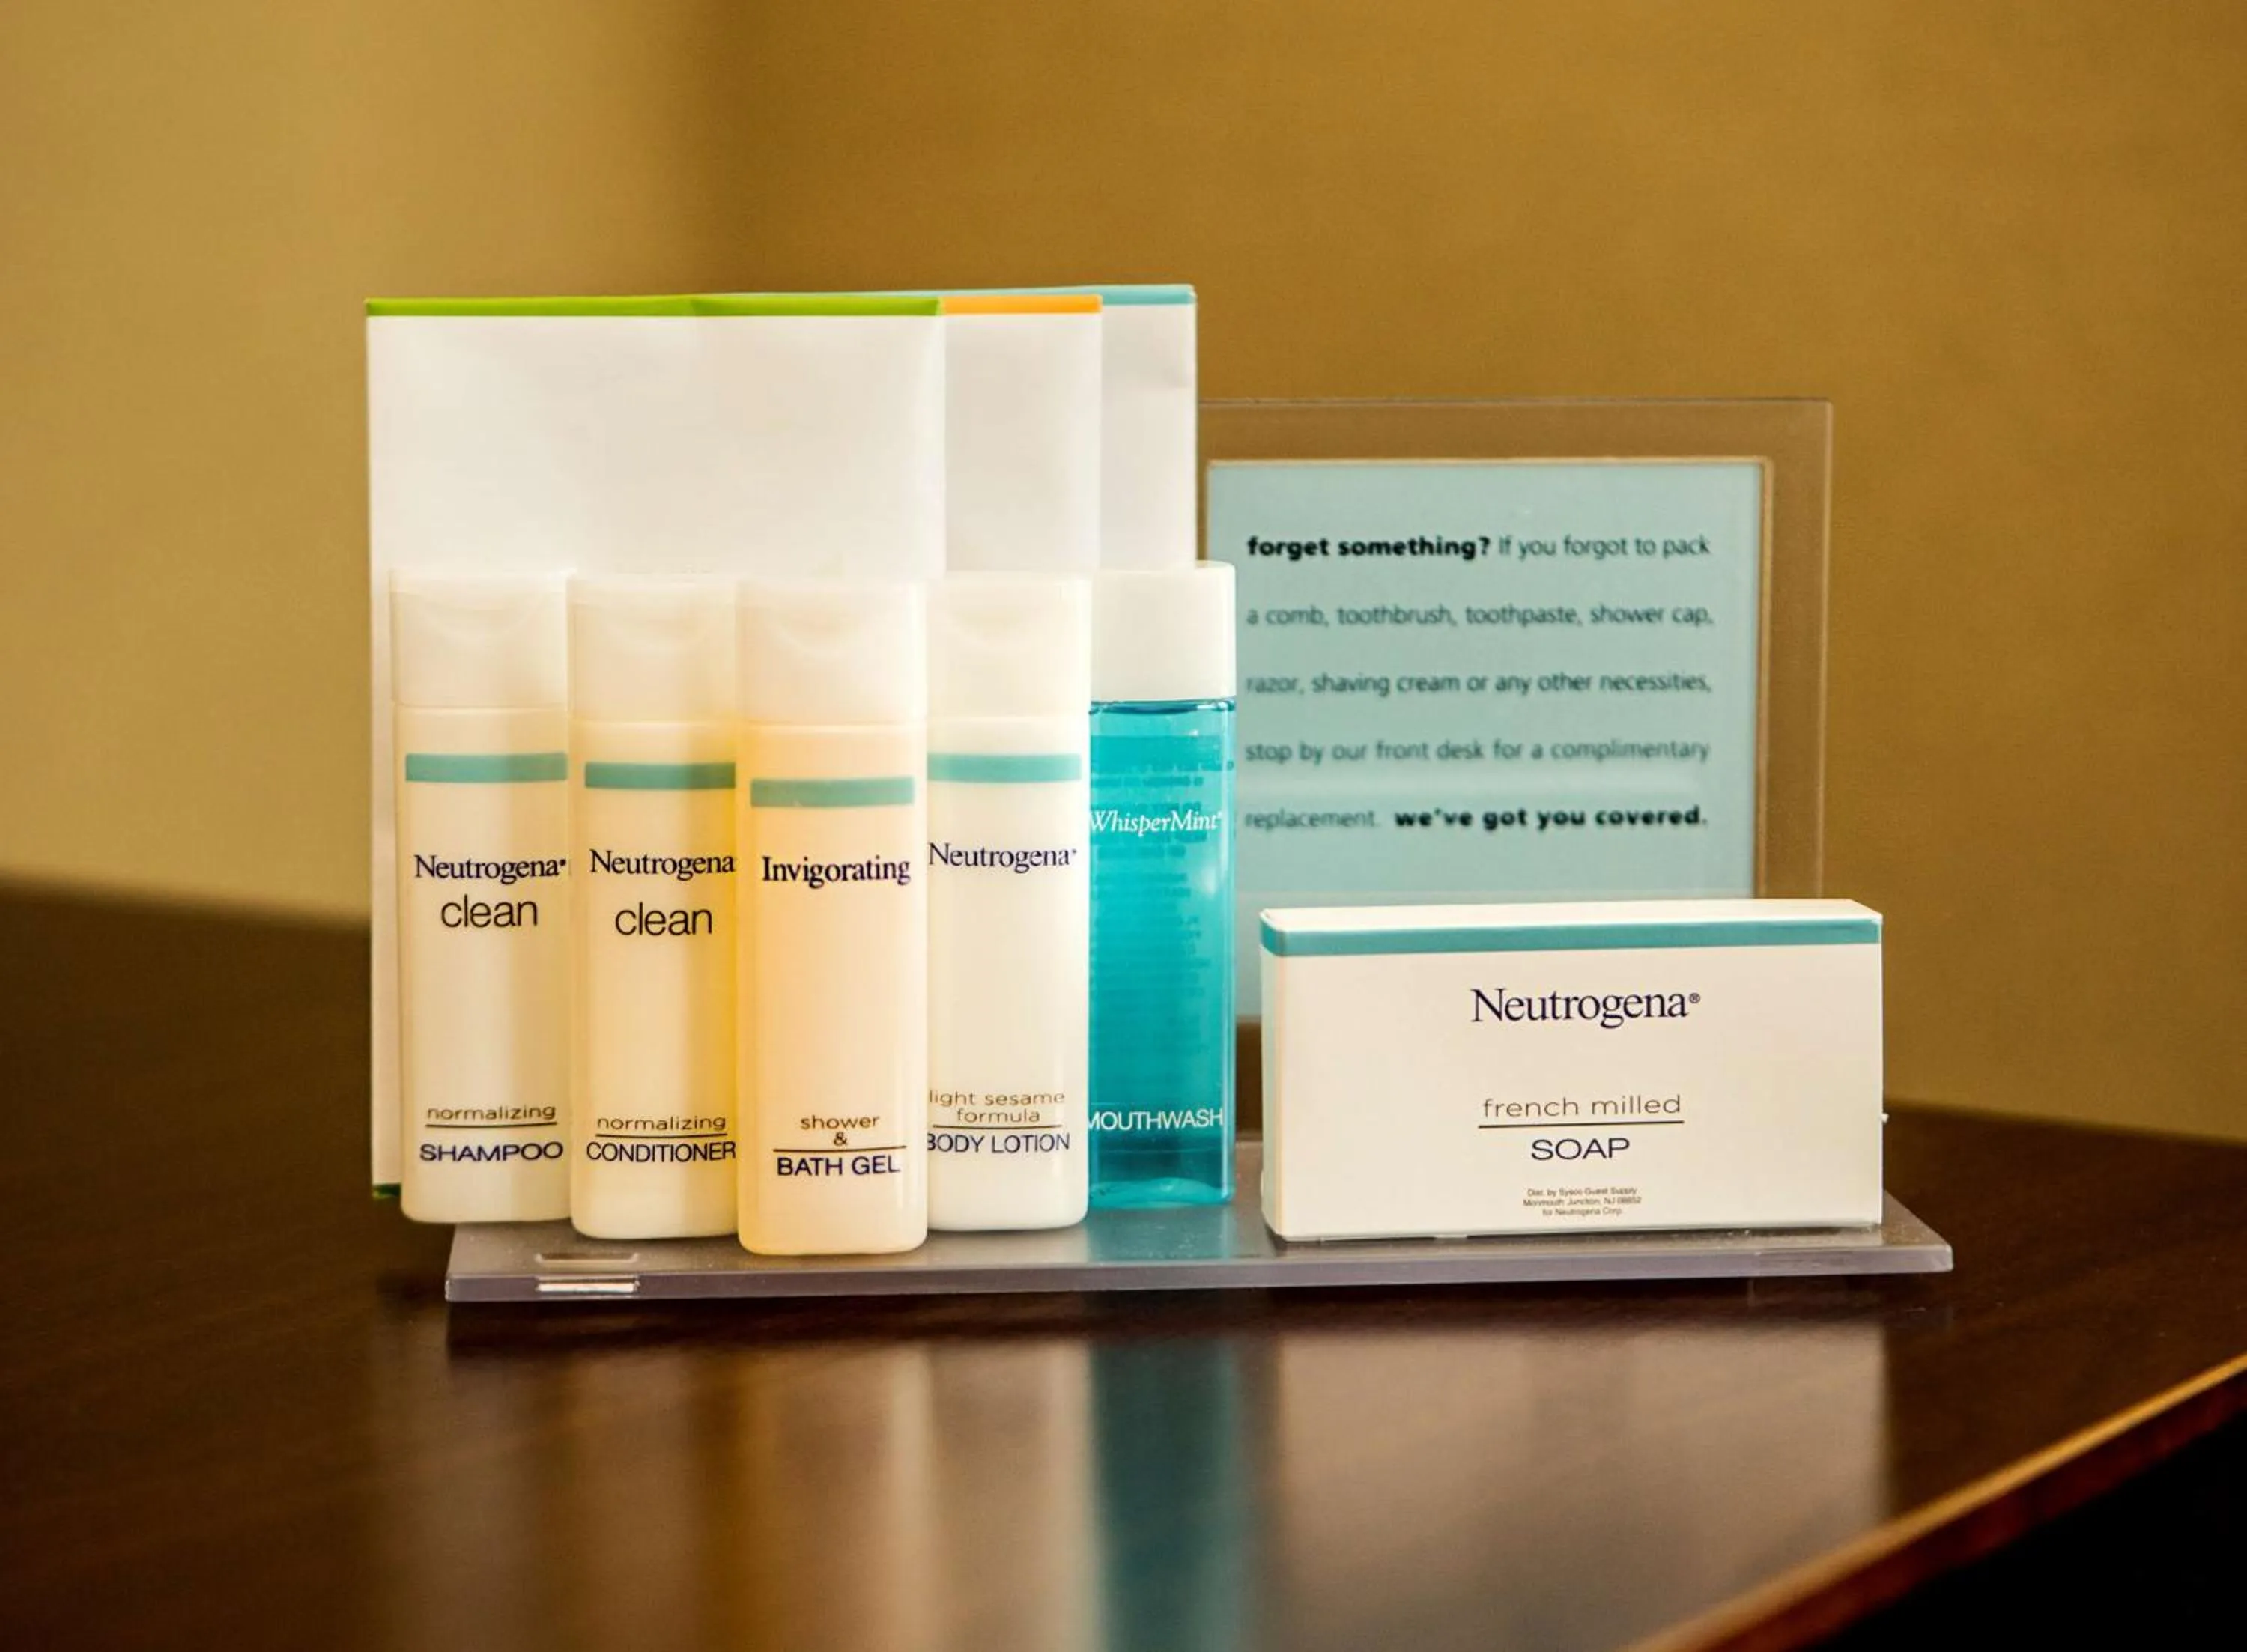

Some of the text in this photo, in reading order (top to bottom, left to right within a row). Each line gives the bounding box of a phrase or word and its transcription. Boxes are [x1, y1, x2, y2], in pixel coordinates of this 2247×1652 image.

[1246, 535, 1711, 562] forget something? If you forgot to pack
[1246, 604, 1714, 628] a comb, toothbrush, toothpaste, shower cap,
[1246, 672, 1713, 697] razor, shaving cream or any other necessities,
[1245, 739, 1711, 765] stop by our front desk for a complimentary
[1246, 805, 1708, 832] replacement. we've got you covered.
[589, 848, 736, 882] Neutrogena
[762, 855, 912, 889] Invigorating
[440, 894, 539, 929] clean
[614, 902, 713, 936] clean
[929, 1090, 1065, 1107] light sesame
[1483, 1094, 1681, 1118] french milled
[426, 1105, 557, 1122] normalizing
[596, 1115, 727, 1132] normalizing
[800, 1114, 879, 1131] shower
[956, 1108, 1040, 1123] formula
[1087, 1108, 1225, 1131] MOUTHWASH
[833, 1131, 849, 1148] &
[991, 1132, 1070, 1154] LOTION
[1531, 1137, 1631, 1161] SOAP
[419, 1141, 564, 1163] SHAMPOO
[586, 1141, 736, 1163] CONDITIONER
[777, 1155, 900, 1176] BATH GEL
[1610, 1186, 1637, 1196] Supply
[1555, 1207, 1601, 1217] Neutrogena
